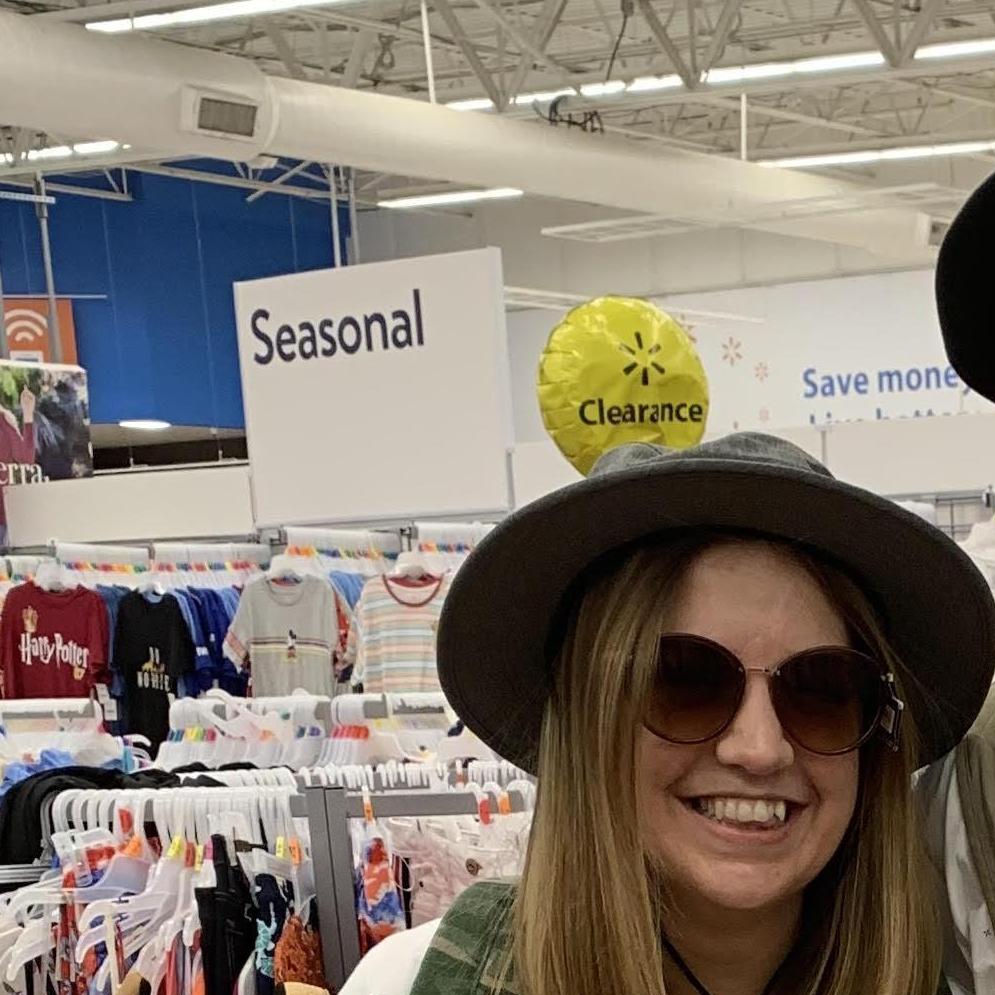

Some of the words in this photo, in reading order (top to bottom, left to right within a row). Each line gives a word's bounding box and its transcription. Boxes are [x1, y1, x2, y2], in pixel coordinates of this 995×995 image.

[251, 288, 424, 365] Seasonal
[803, 367, 869, 398] Save
[877, 365, 971, 396] mone
[578, 398, 703, 426] Clearance
[0, 461, 50, 485] erra.
[19, 633, 55, 665] Harry
[53, 633, 89, 669] Potter
